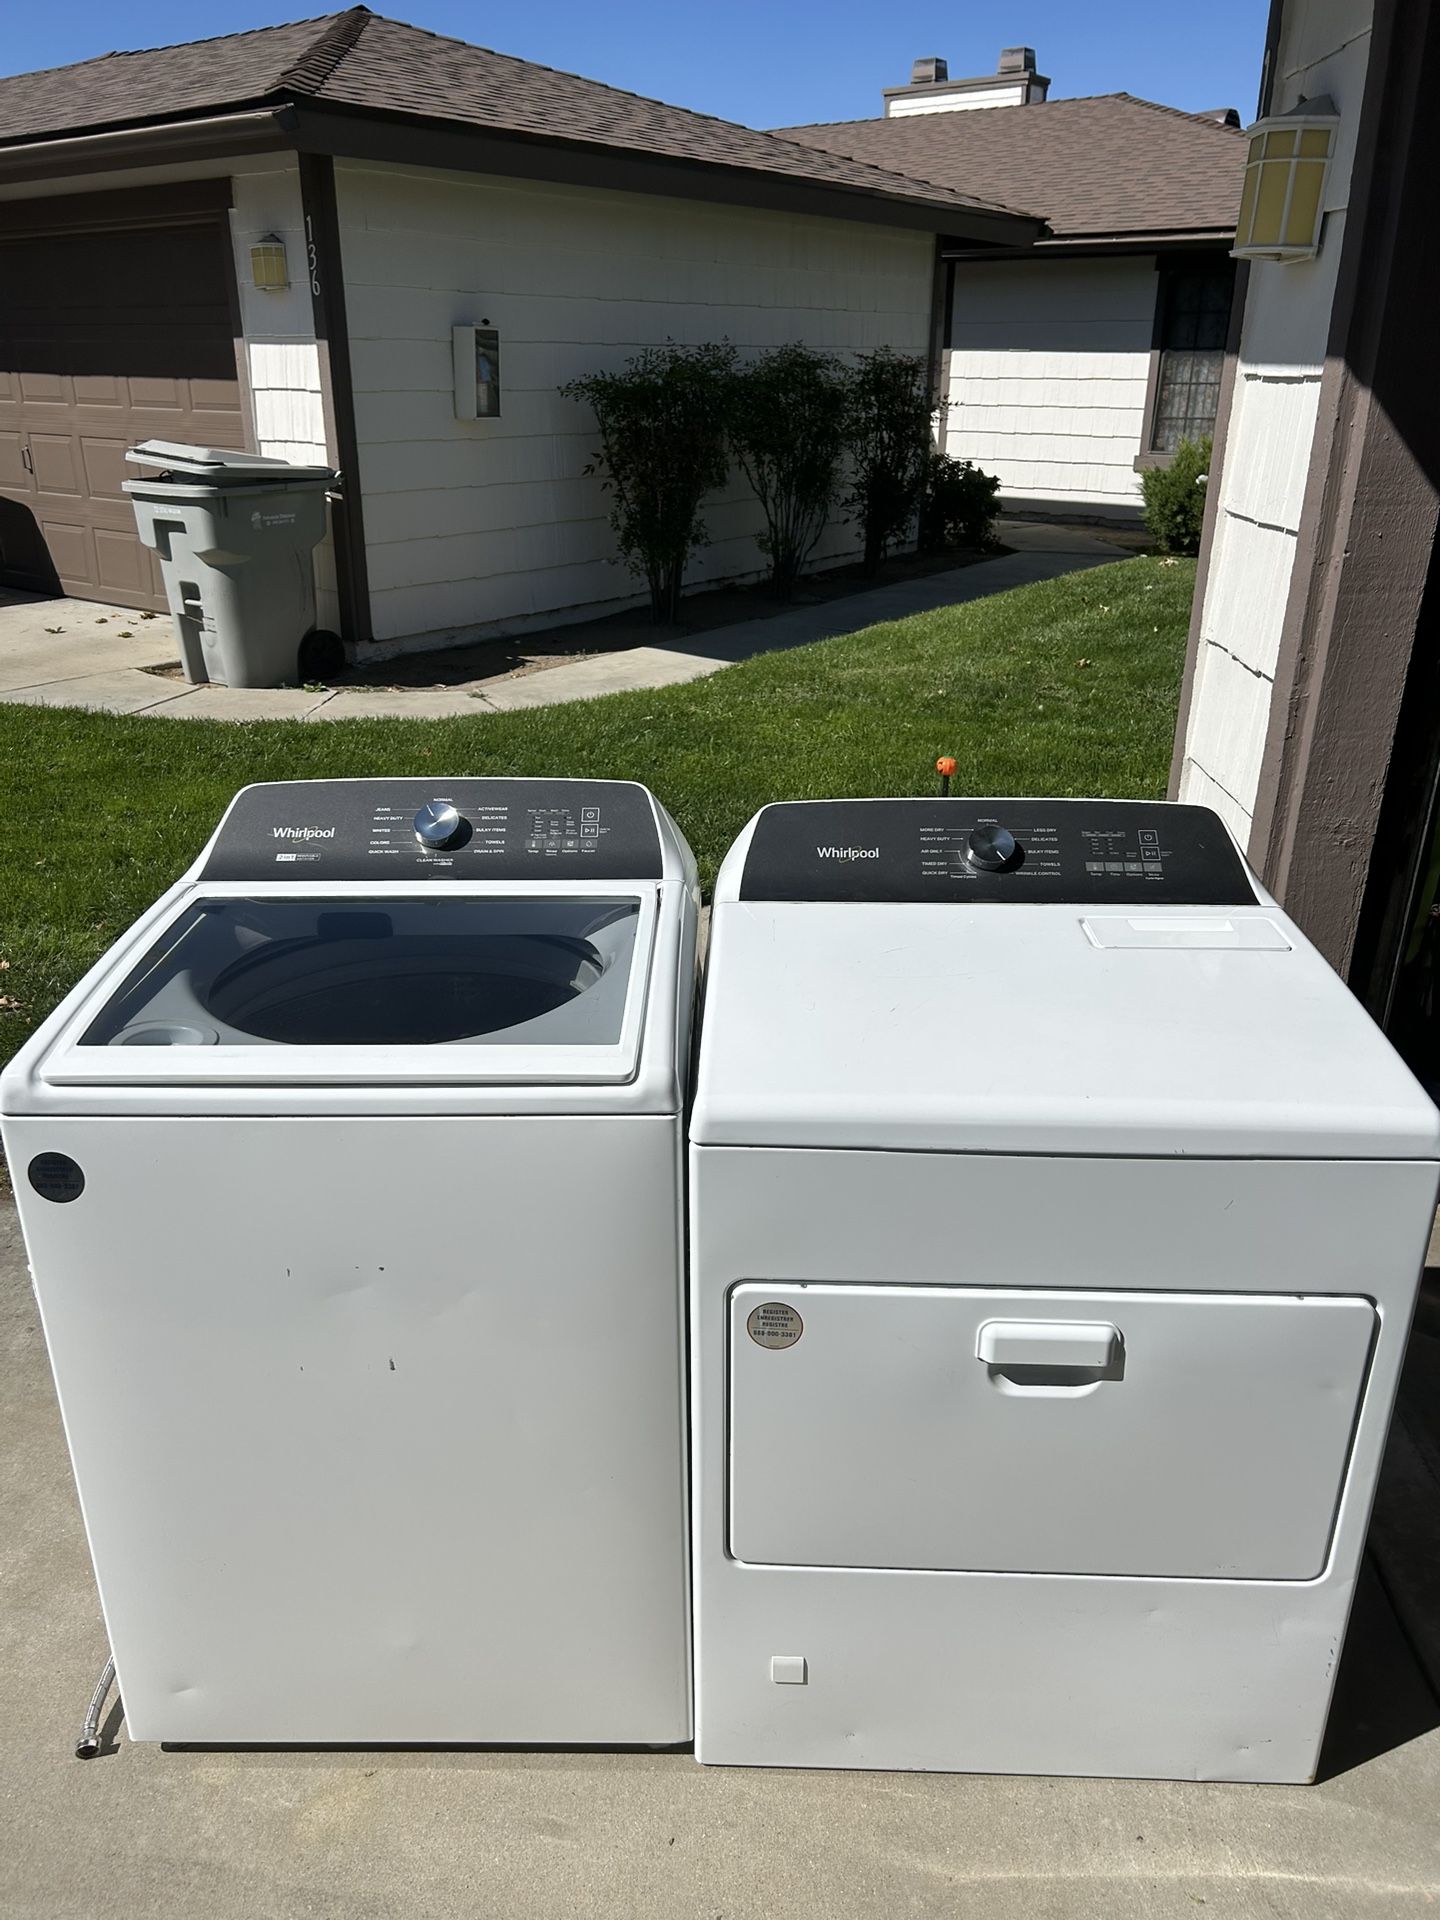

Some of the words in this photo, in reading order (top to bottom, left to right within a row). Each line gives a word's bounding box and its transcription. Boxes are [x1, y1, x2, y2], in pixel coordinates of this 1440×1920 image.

[306, 215, 320, 295] 136
[273, 827, 335, 840] Whirlpool
[816, 847, 879, 861] Whirlpool
